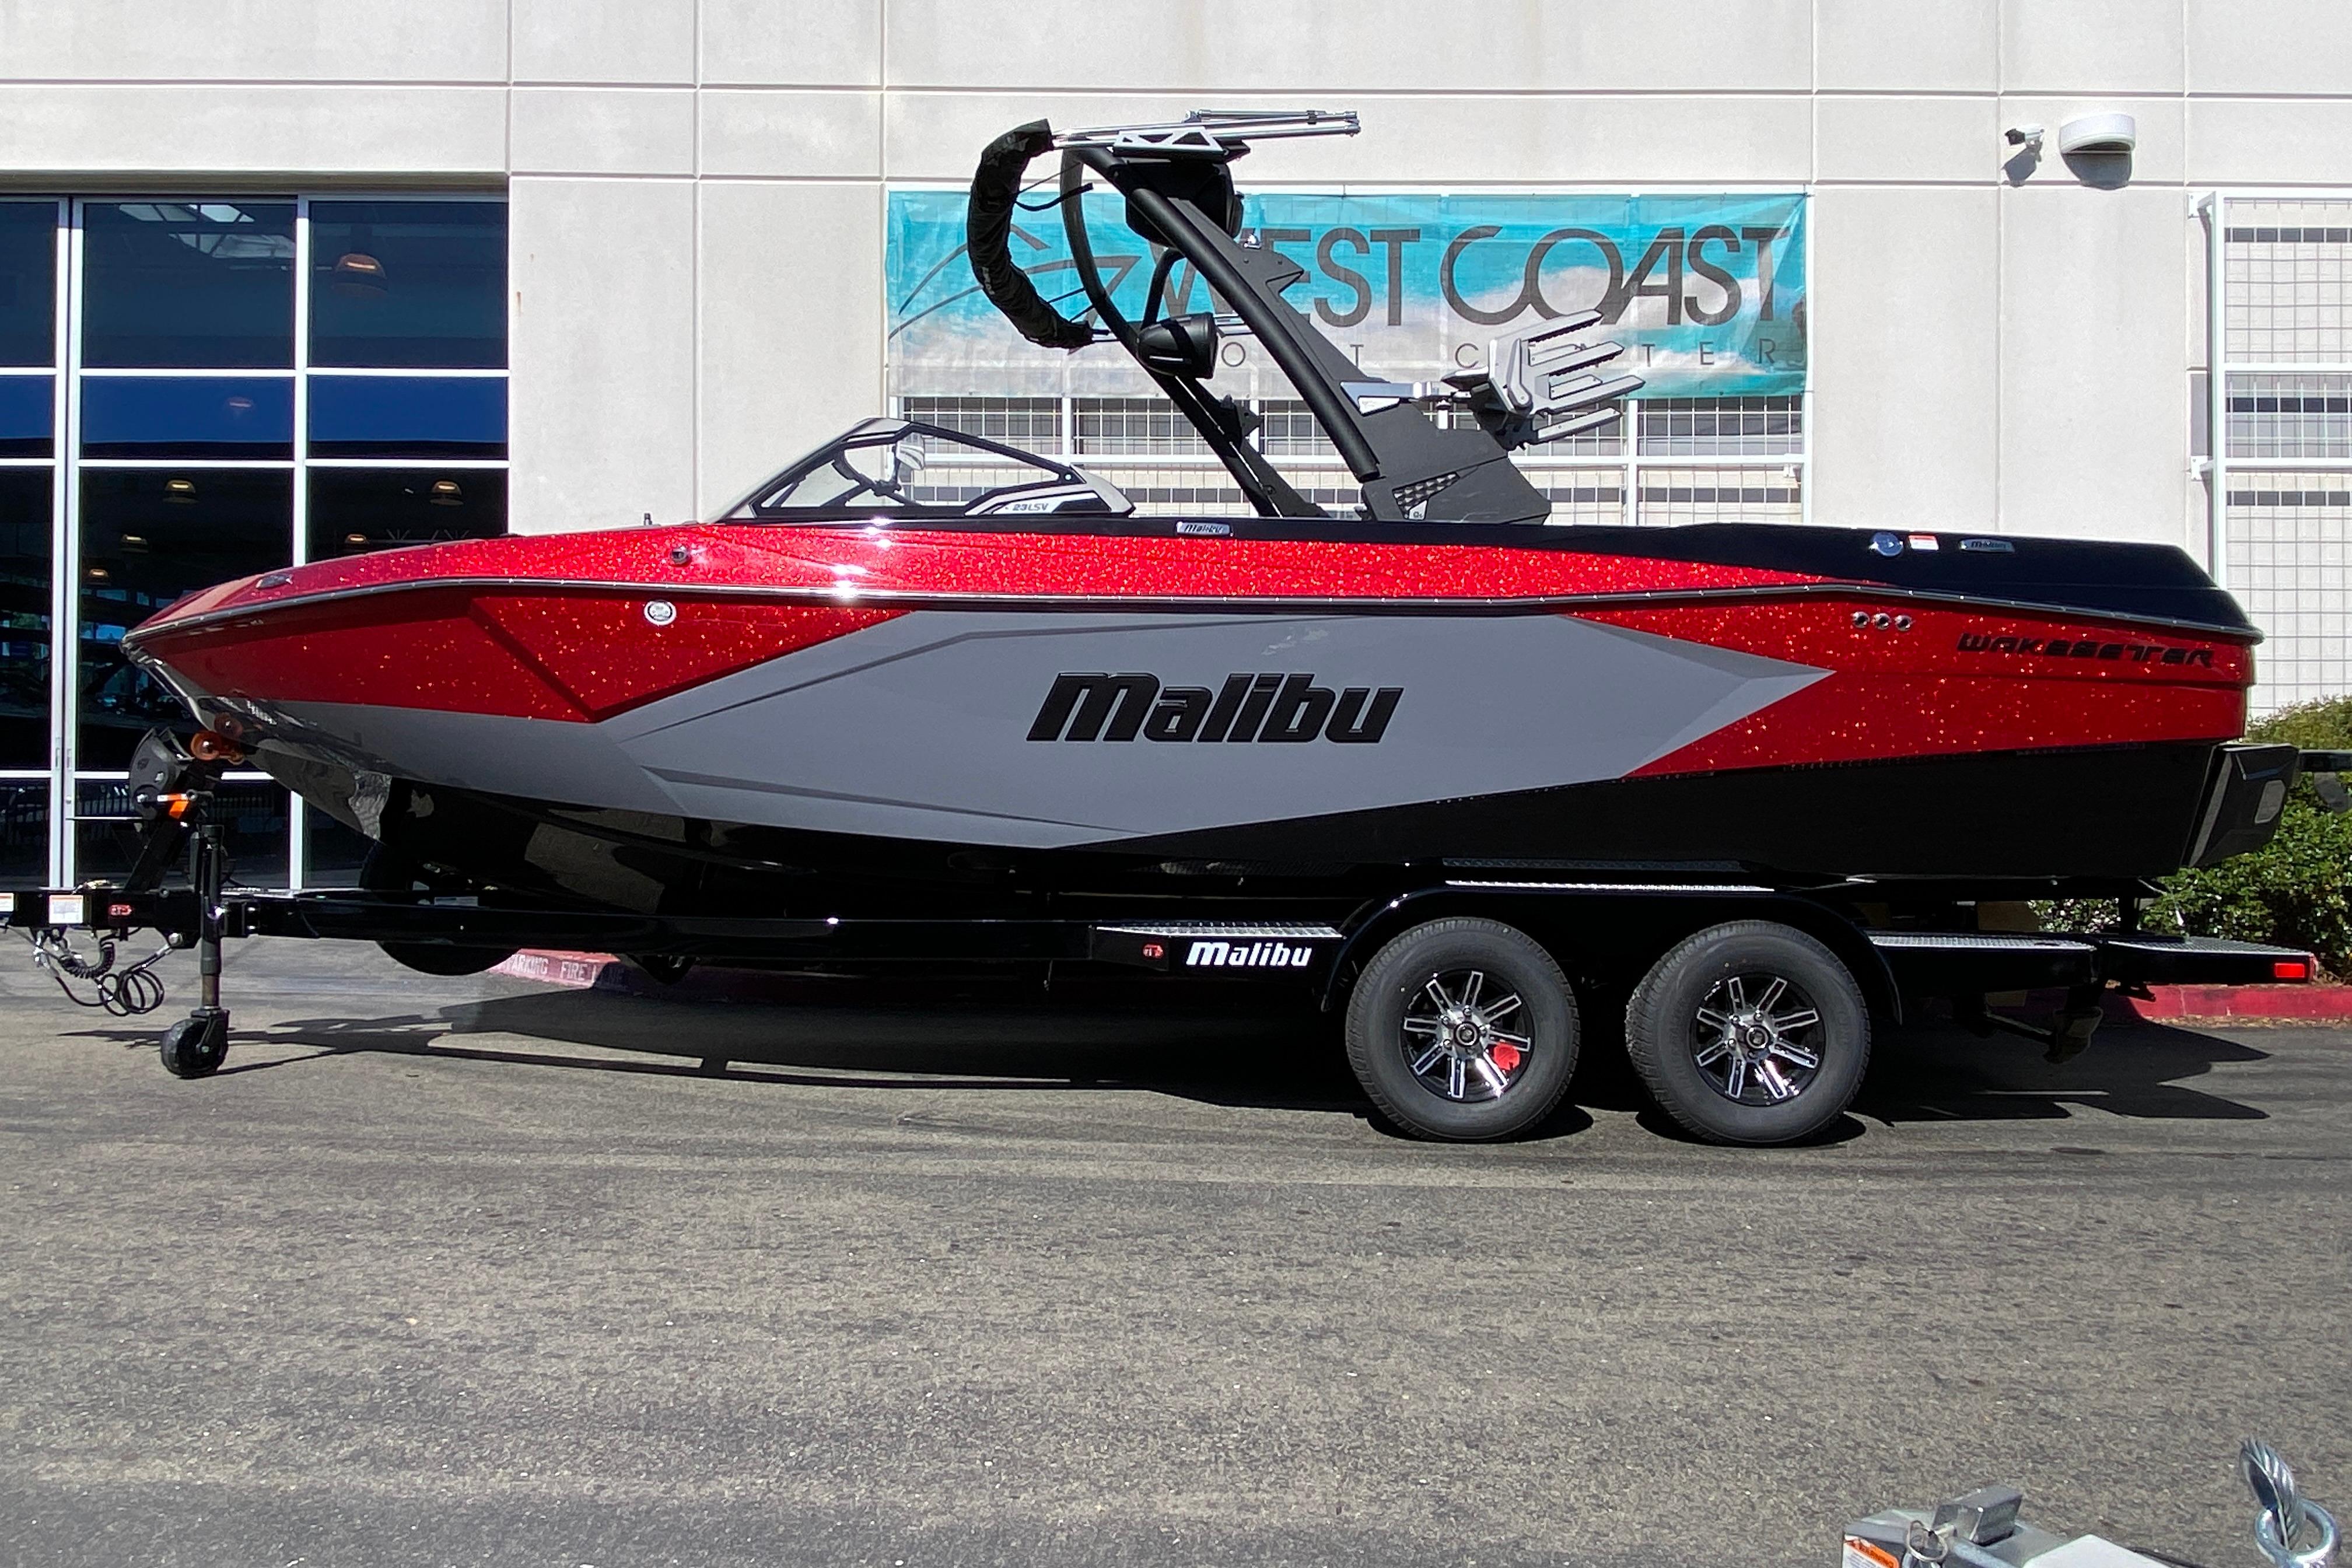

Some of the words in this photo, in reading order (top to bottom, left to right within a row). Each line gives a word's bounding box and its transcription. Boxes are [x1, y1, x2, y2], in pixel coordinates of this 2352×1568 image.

[1440, 224, 1790, 326] COAST
[1455, 338, 1779, 369] CTER
[1012, 502, 1049, 511] 23LSV
[1956, 632, 2216, 669] WAKESETTER
[1026, 672, 1405, 744] Malibu
[1185, 942, 1312, 967] Malibu
[559, 961, 588, 981] FIRE
